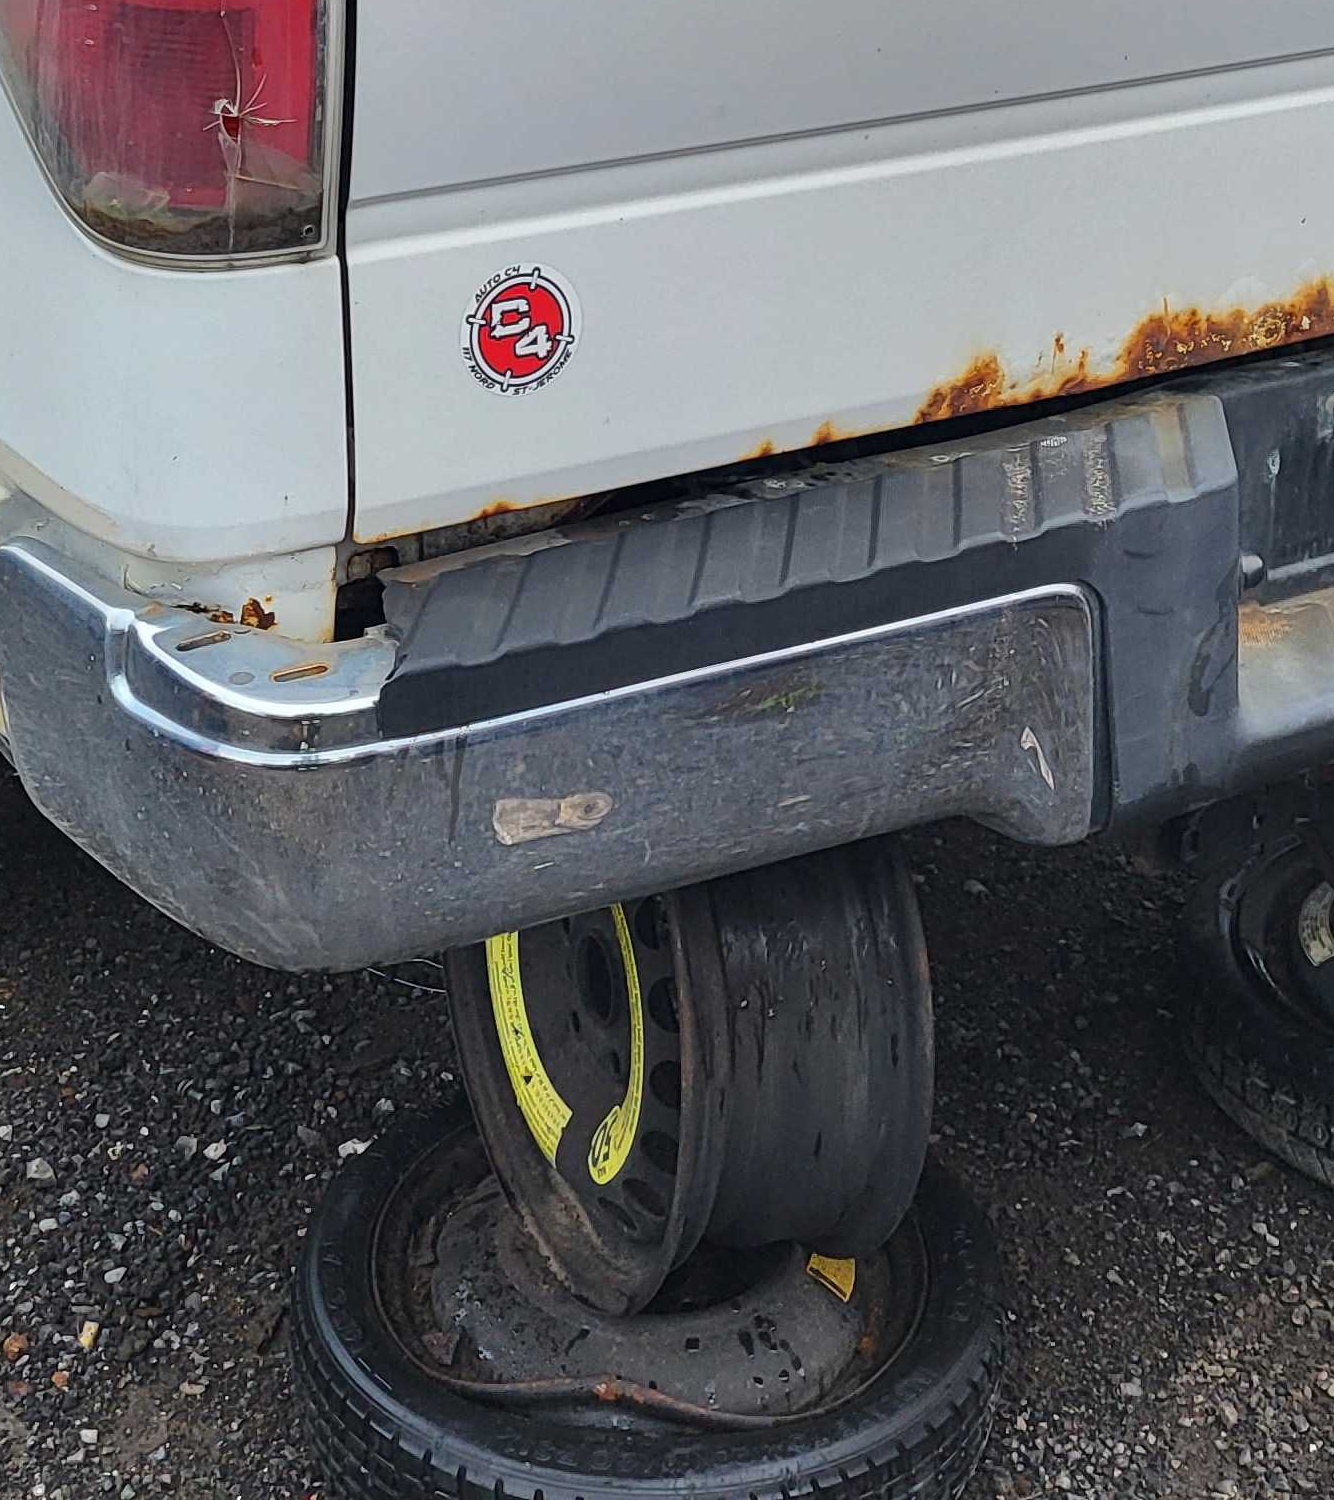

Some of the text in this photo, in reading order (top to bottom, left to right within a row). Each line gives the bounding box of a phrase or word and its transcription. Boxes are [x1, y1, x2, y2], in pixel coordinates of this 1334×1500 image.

[474, 265, 521, 304] AUTO C4
[468, 364, 496, 390] NORD
